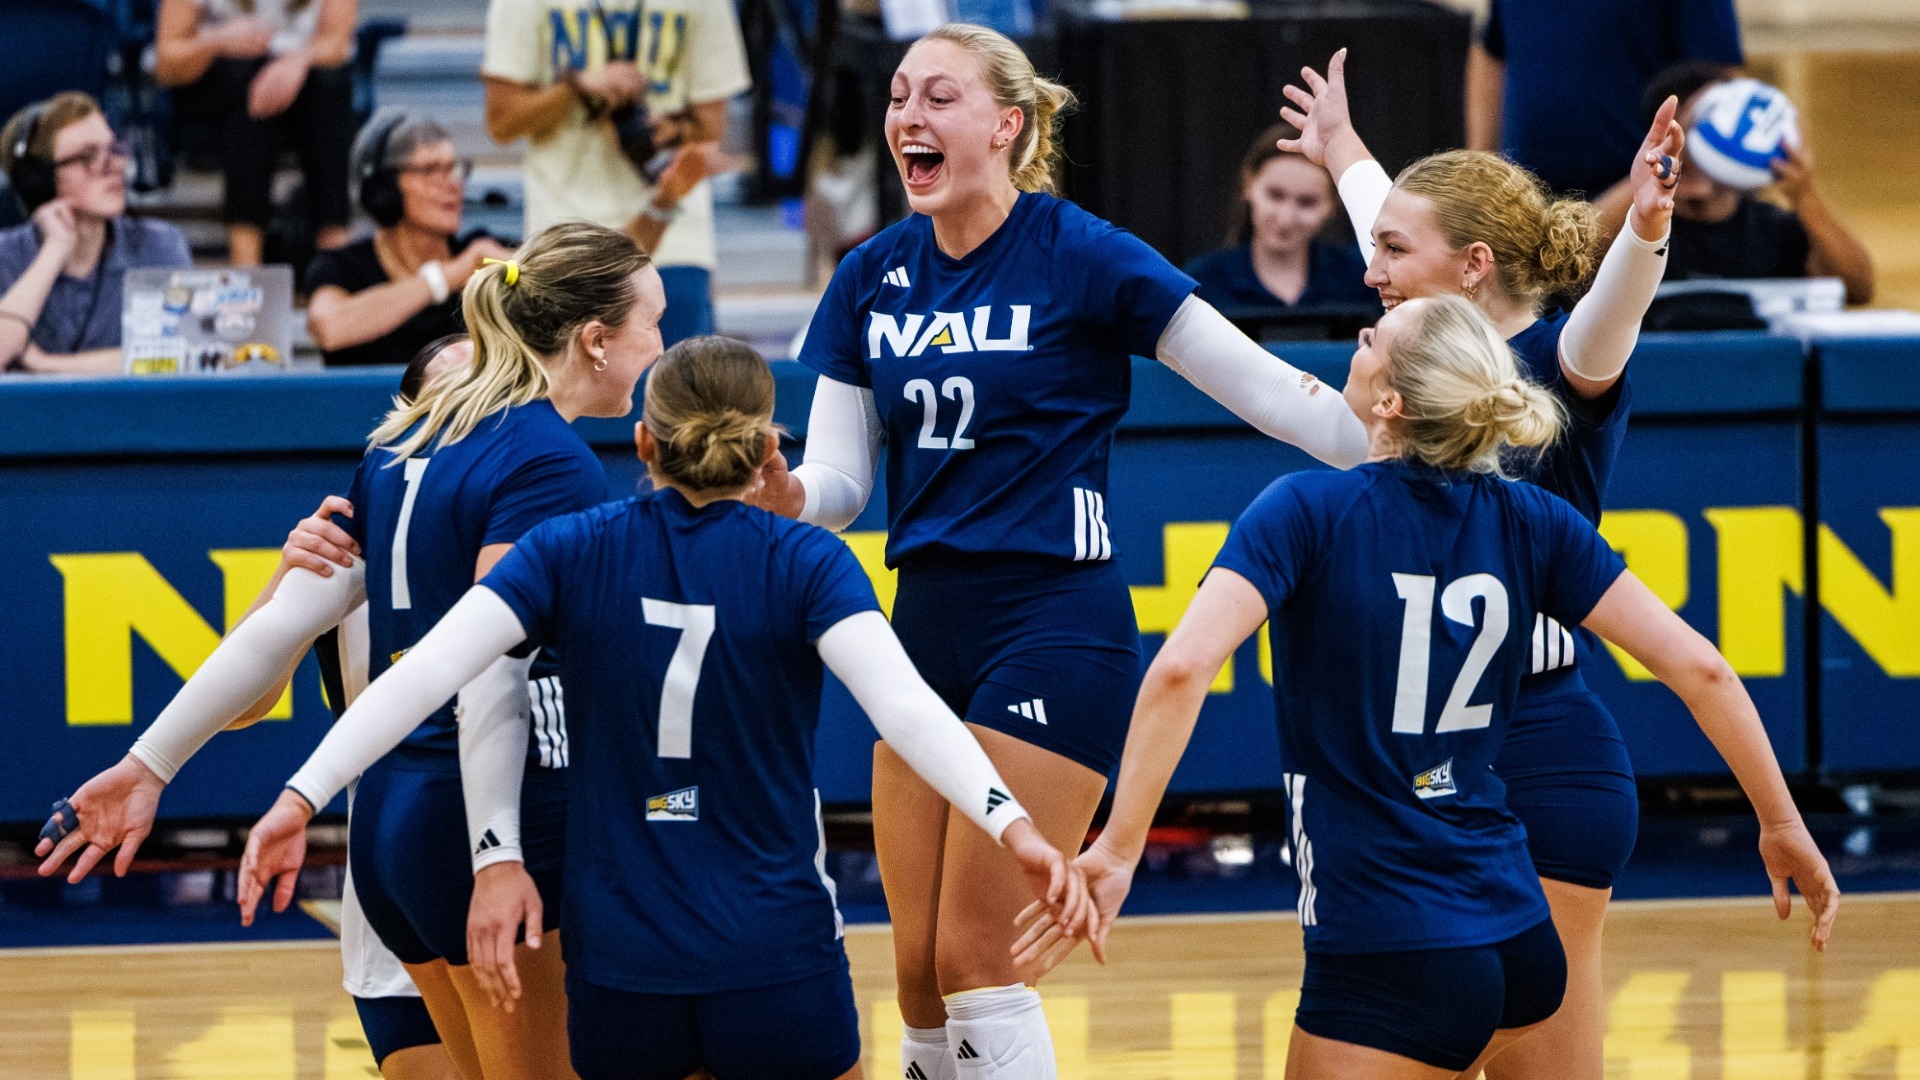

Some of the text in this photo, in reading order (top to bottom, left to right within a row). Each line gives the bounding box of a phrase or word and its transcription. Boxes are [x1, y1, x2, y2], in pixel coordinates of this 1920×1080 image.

[868, 305, 1031, 359] NAU
[903, 376, 975, 449] 22
[391, 457, 431, 609] 1
[641, 597, 716, 759] 7
[1391, 572, 1509, 734] 12
